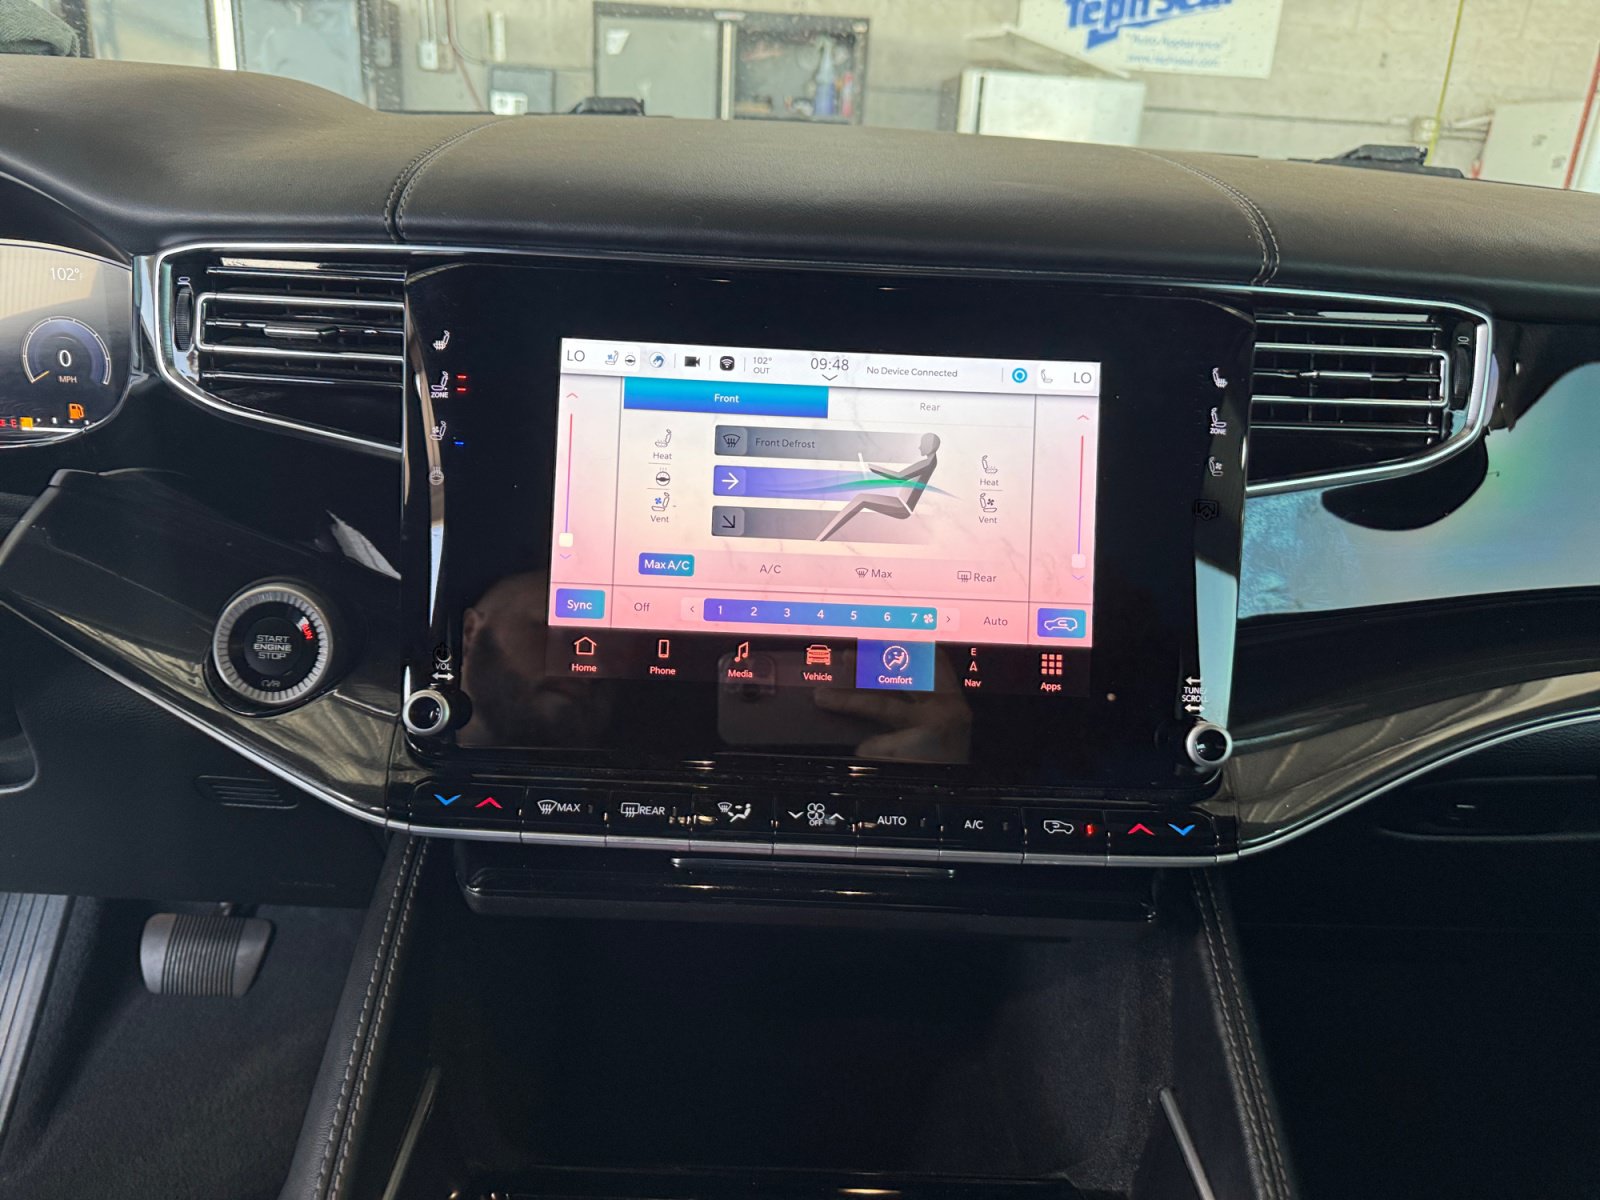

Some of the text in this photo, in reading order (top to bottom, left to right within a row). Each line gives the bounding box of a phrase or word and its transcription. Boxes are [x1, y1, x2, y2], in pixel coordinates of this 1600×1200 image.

[59, 350, 72, 367] 0
[566, 349, 585, 363] LO
[753, 356, 773, 365] 102°
[810, 358, 849, 371] 09:48
[866, 366, 958, 378] No Device Connected
[58, 375, 78, 384] MPH
[1073, 372, 1092, 384] LO
[430, 391, 449, 399] ZONE
[714, 393, 740, 403] Front
[919, 402, 940, 412] Rear
[755, 437, 815, 449] Front Defrost
[653, 452, 673, 460] Heat
[979, 478, 999, 487] Heat
[650, 514, 669, 523] Vent
[978, 515, 998, 524] Vent
[644, 560, 690, 571] Max A/C
[759, 563, 782, 575] A/C
[871, 569, 893, 579] Max
[973, 573, 997, 583] Rear
[567, 599, 592, 611] Sync
[633, 602, 650, 612] Off
[750, 606, 758, 617] 2
[783, 607, 791, 618] 3
[816, 609, 825, 619] 4
[850, 610, 858, 620] 5
[883, 612, 891, 622] 6
[910, 612, 918, 622] 7
[983, 616, 1009, 626] Auto
[256, 634, 290, 643] START
[253, 643, 292, 652] ENGINE
[970, 648, 977, 656] E
[257, 652, 287, 660] STOP
[435, 663, 452, 671] VOL
[571, 663, 597, 673] Home
[649, 666, 676, 676] Phone
[727, 669, 753, 679] Media
[803, 671, 833, 682] Vehicle
[878, 674, 913, 685] Comfort
[964, 678, 982, 688] Nav
[1040, 682, 1062, 692] Apps
[1181, 695, 1208, 703] SCROLL
[556, 803, 581, 813] MAX
[639, 805, 665, 816] REAR
[809, 819, 823, 827] OFF
[877, 815, 907, 826] AUTO
[964, 820, 984, 830] A/C
